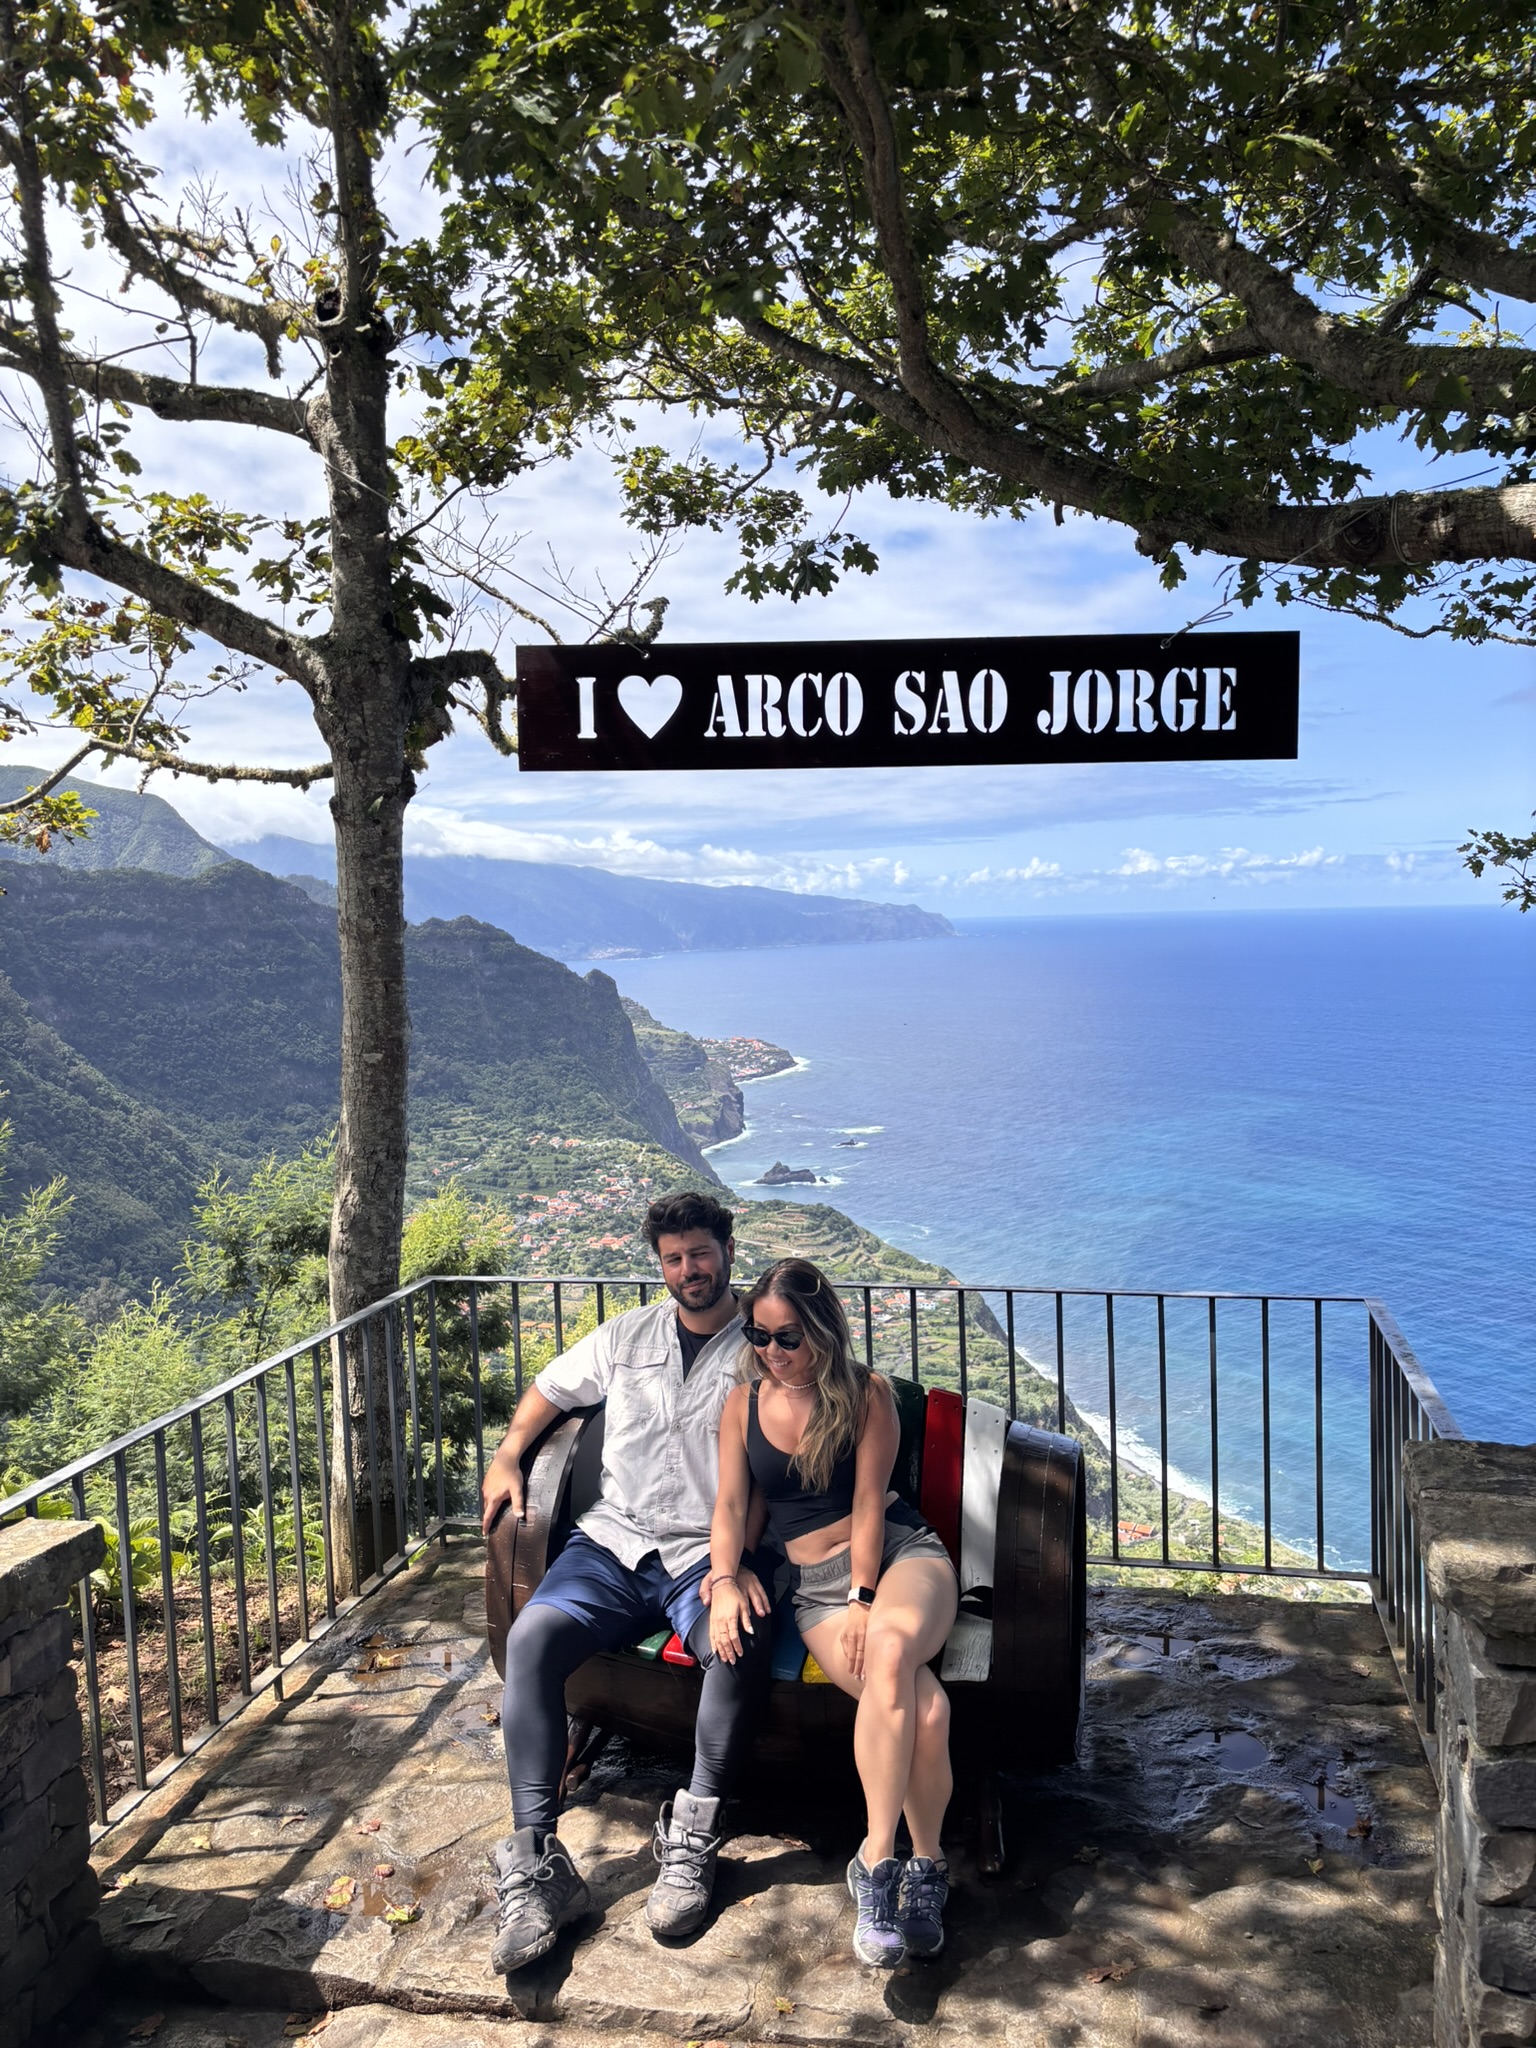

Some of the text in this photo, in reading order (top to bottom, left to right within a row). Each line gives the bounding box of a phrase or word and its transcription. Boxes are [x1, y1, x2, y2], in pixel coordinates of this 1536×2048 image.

[576, 667, 1237, 739] I ARCO SAO JORGE
